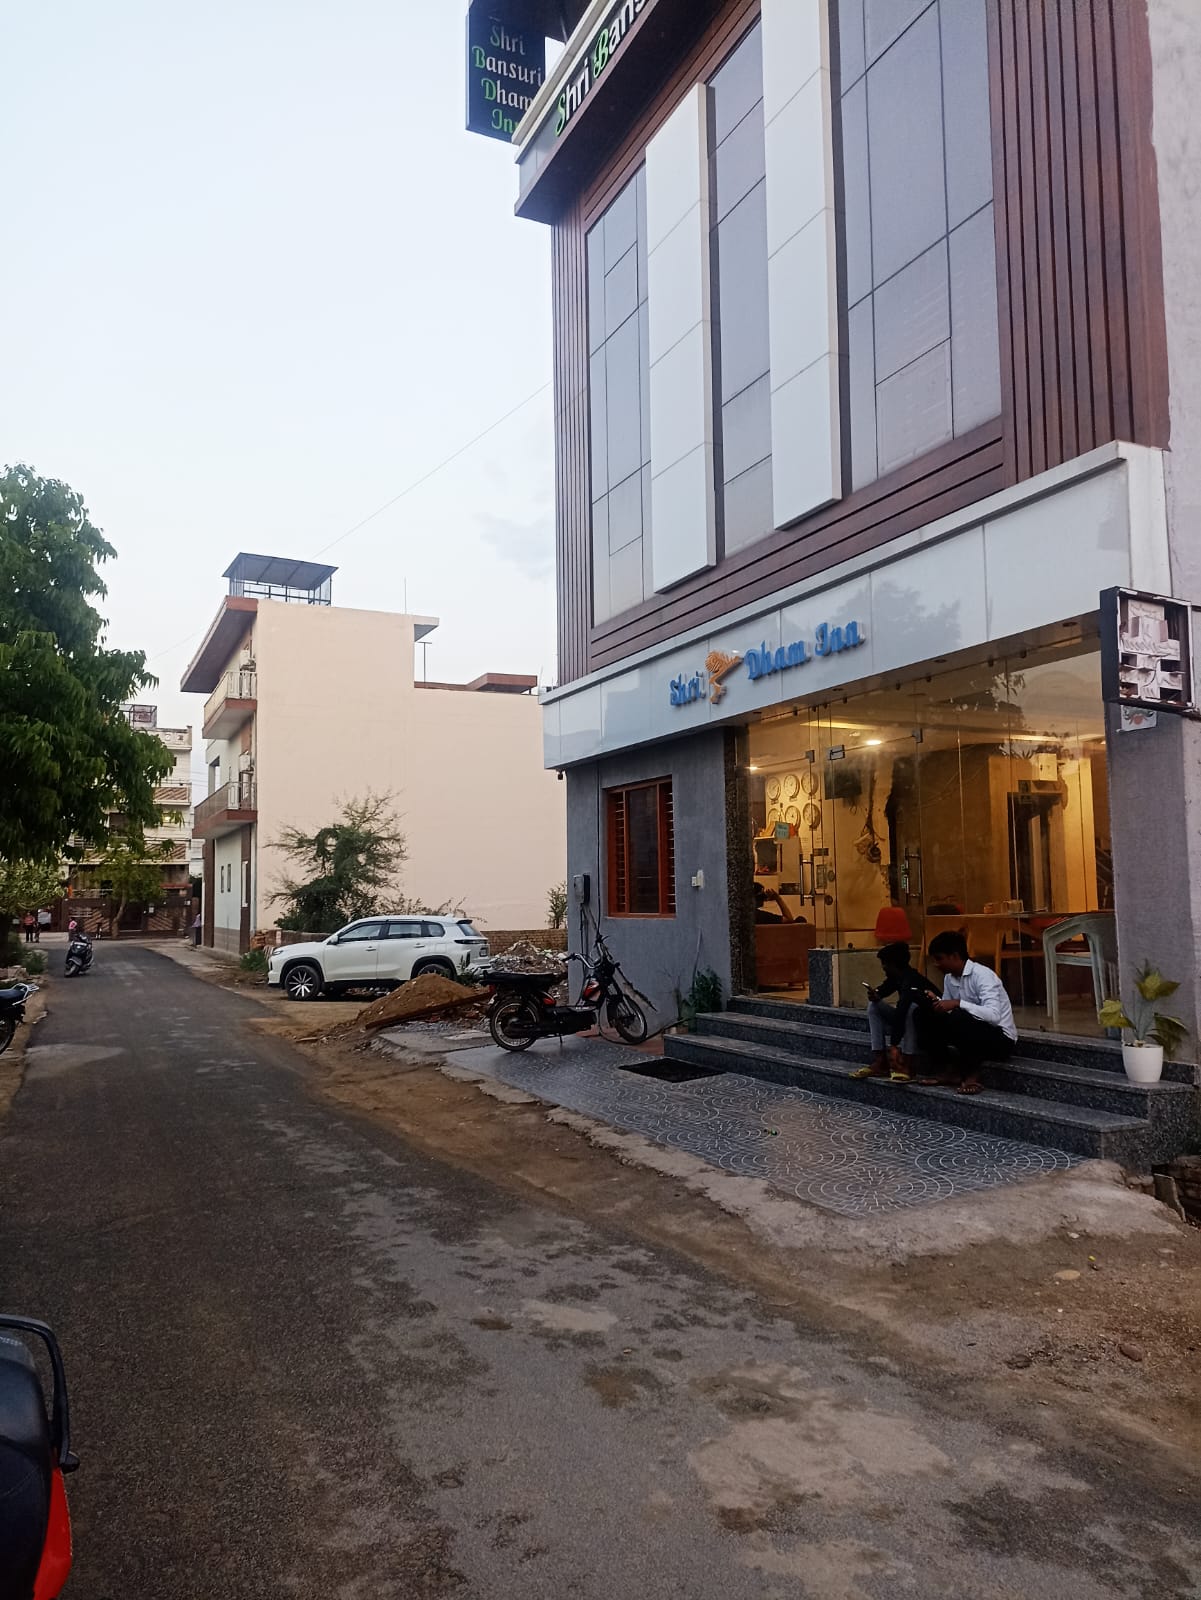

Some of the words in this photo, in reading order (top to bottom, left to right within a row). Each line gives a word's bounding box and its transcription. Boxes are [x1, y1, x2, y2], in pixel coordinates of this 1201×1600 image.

[490, 24, 525, 55] Shri
[472, 45, 542, 87] Bansuri
[481, 78, 533, 111] Dham
[555, 57, 589, 137] Shri
[670, 671, 705, 706] Shri
[744, 640, 807, 680] Dham
[815, 621, 861, 656] Inn
